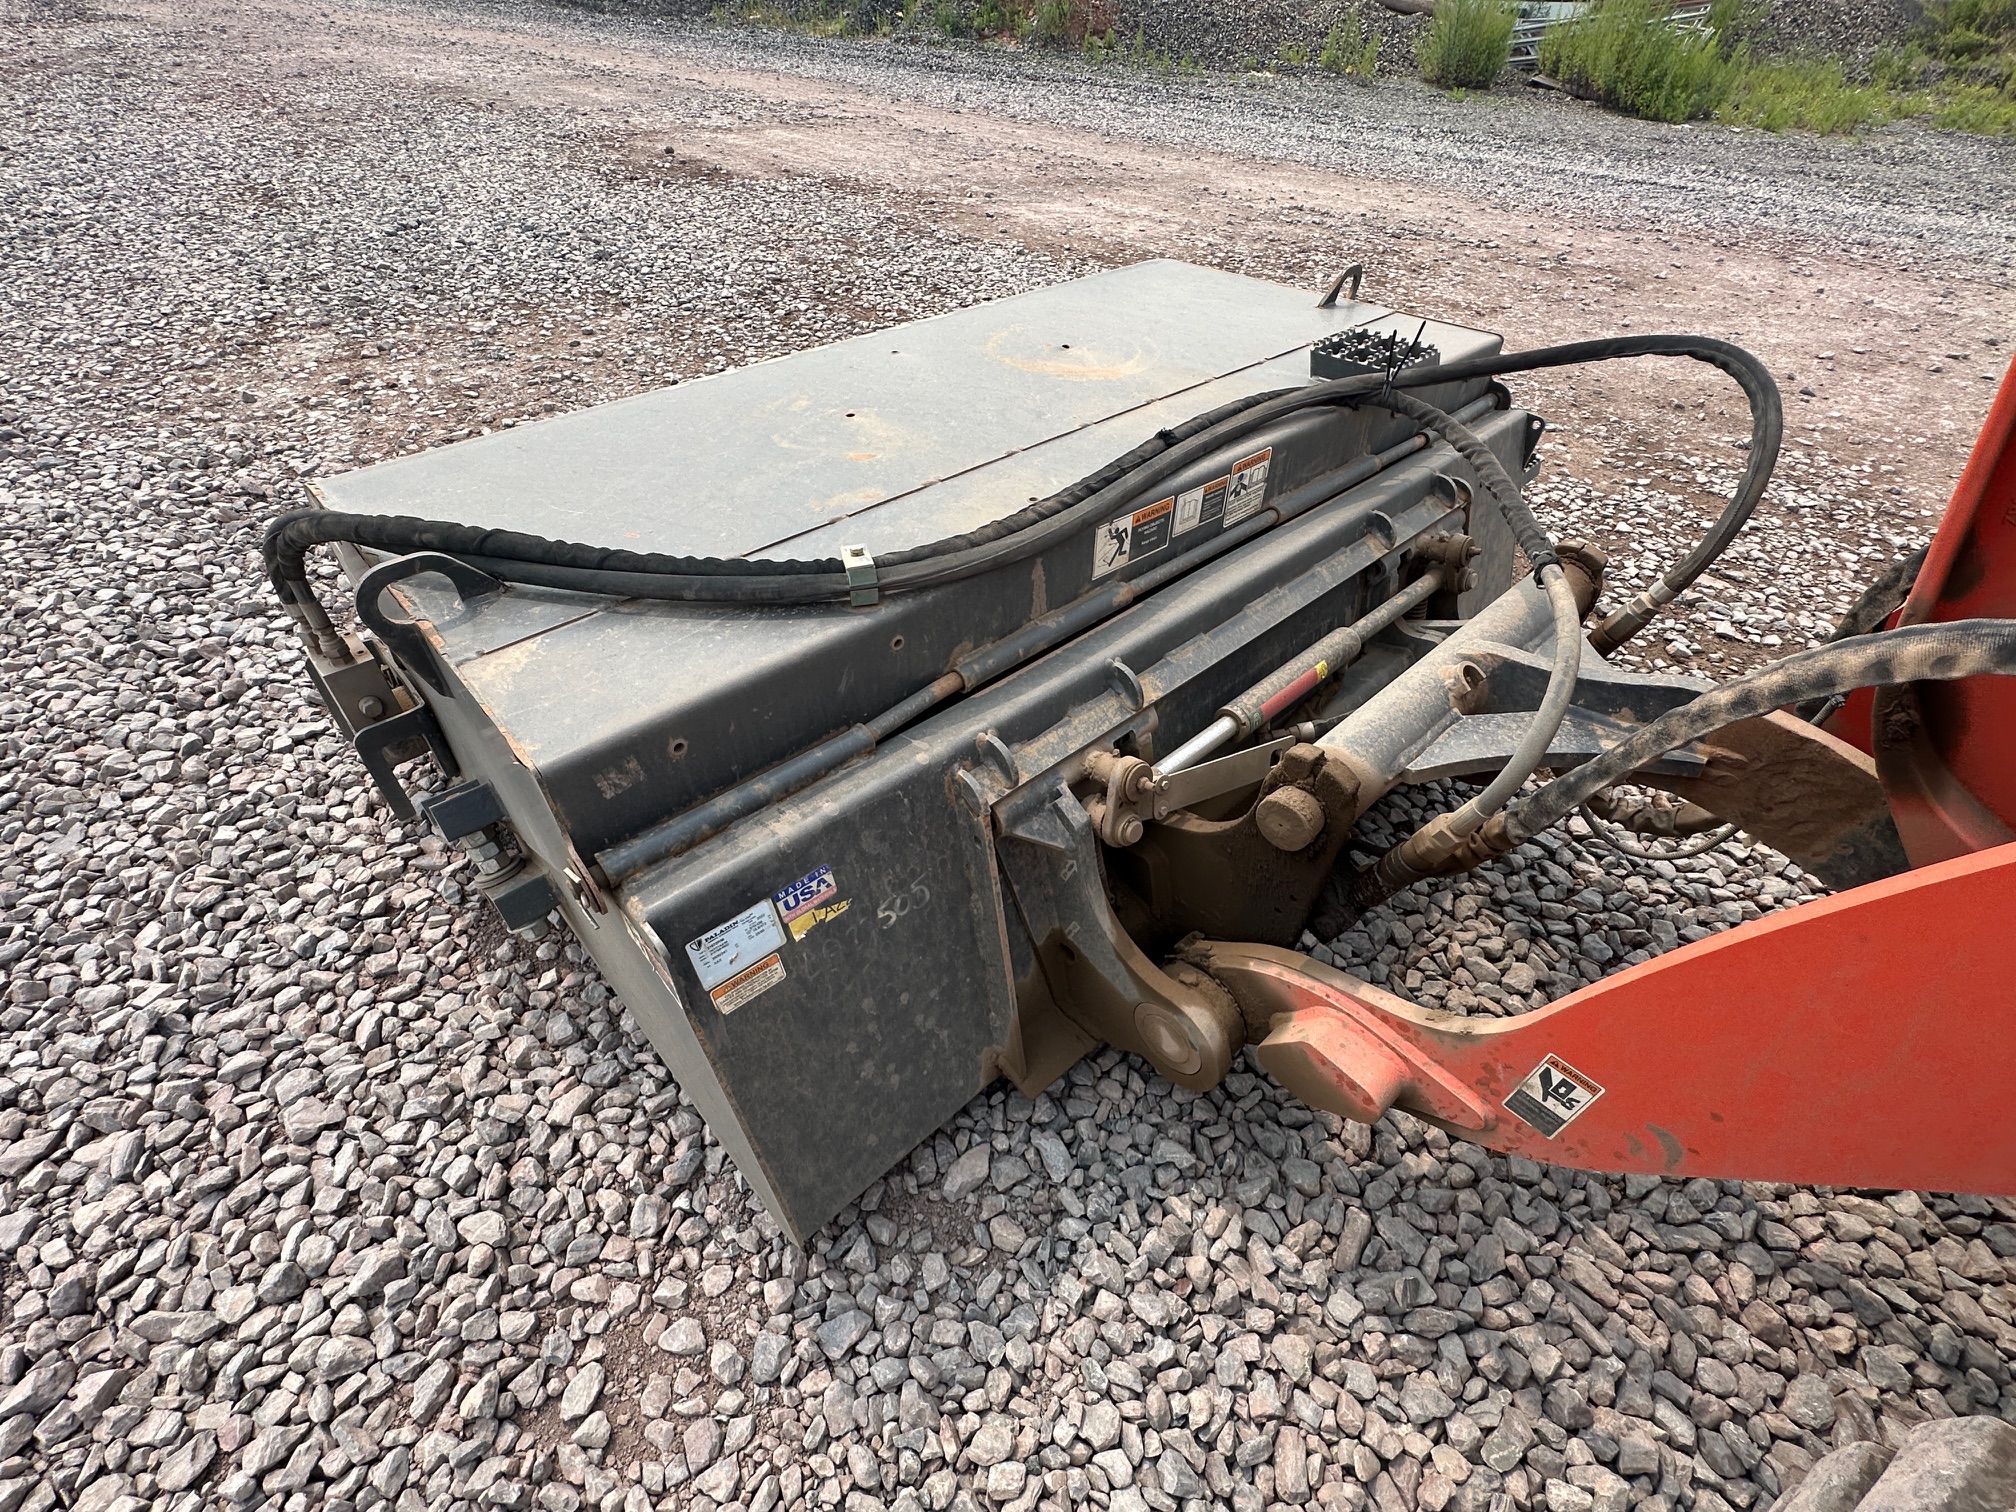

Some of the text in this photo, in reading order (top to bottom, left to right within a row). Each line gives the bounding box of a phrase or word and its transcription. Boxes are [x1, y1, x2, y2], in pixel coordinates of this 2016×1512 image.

[1241, 454, 1266, 469] WARNING
[1142, 503, 1170, 520] WARNING
[778, 867, 827, 899] MADE IN
[782, 877, 832, 912] USA
[704, 920, 740, 943] PALADIN
[731, 962, 770, 988] WARNING
[1561, 1066, 1597, 1092] WARNING
